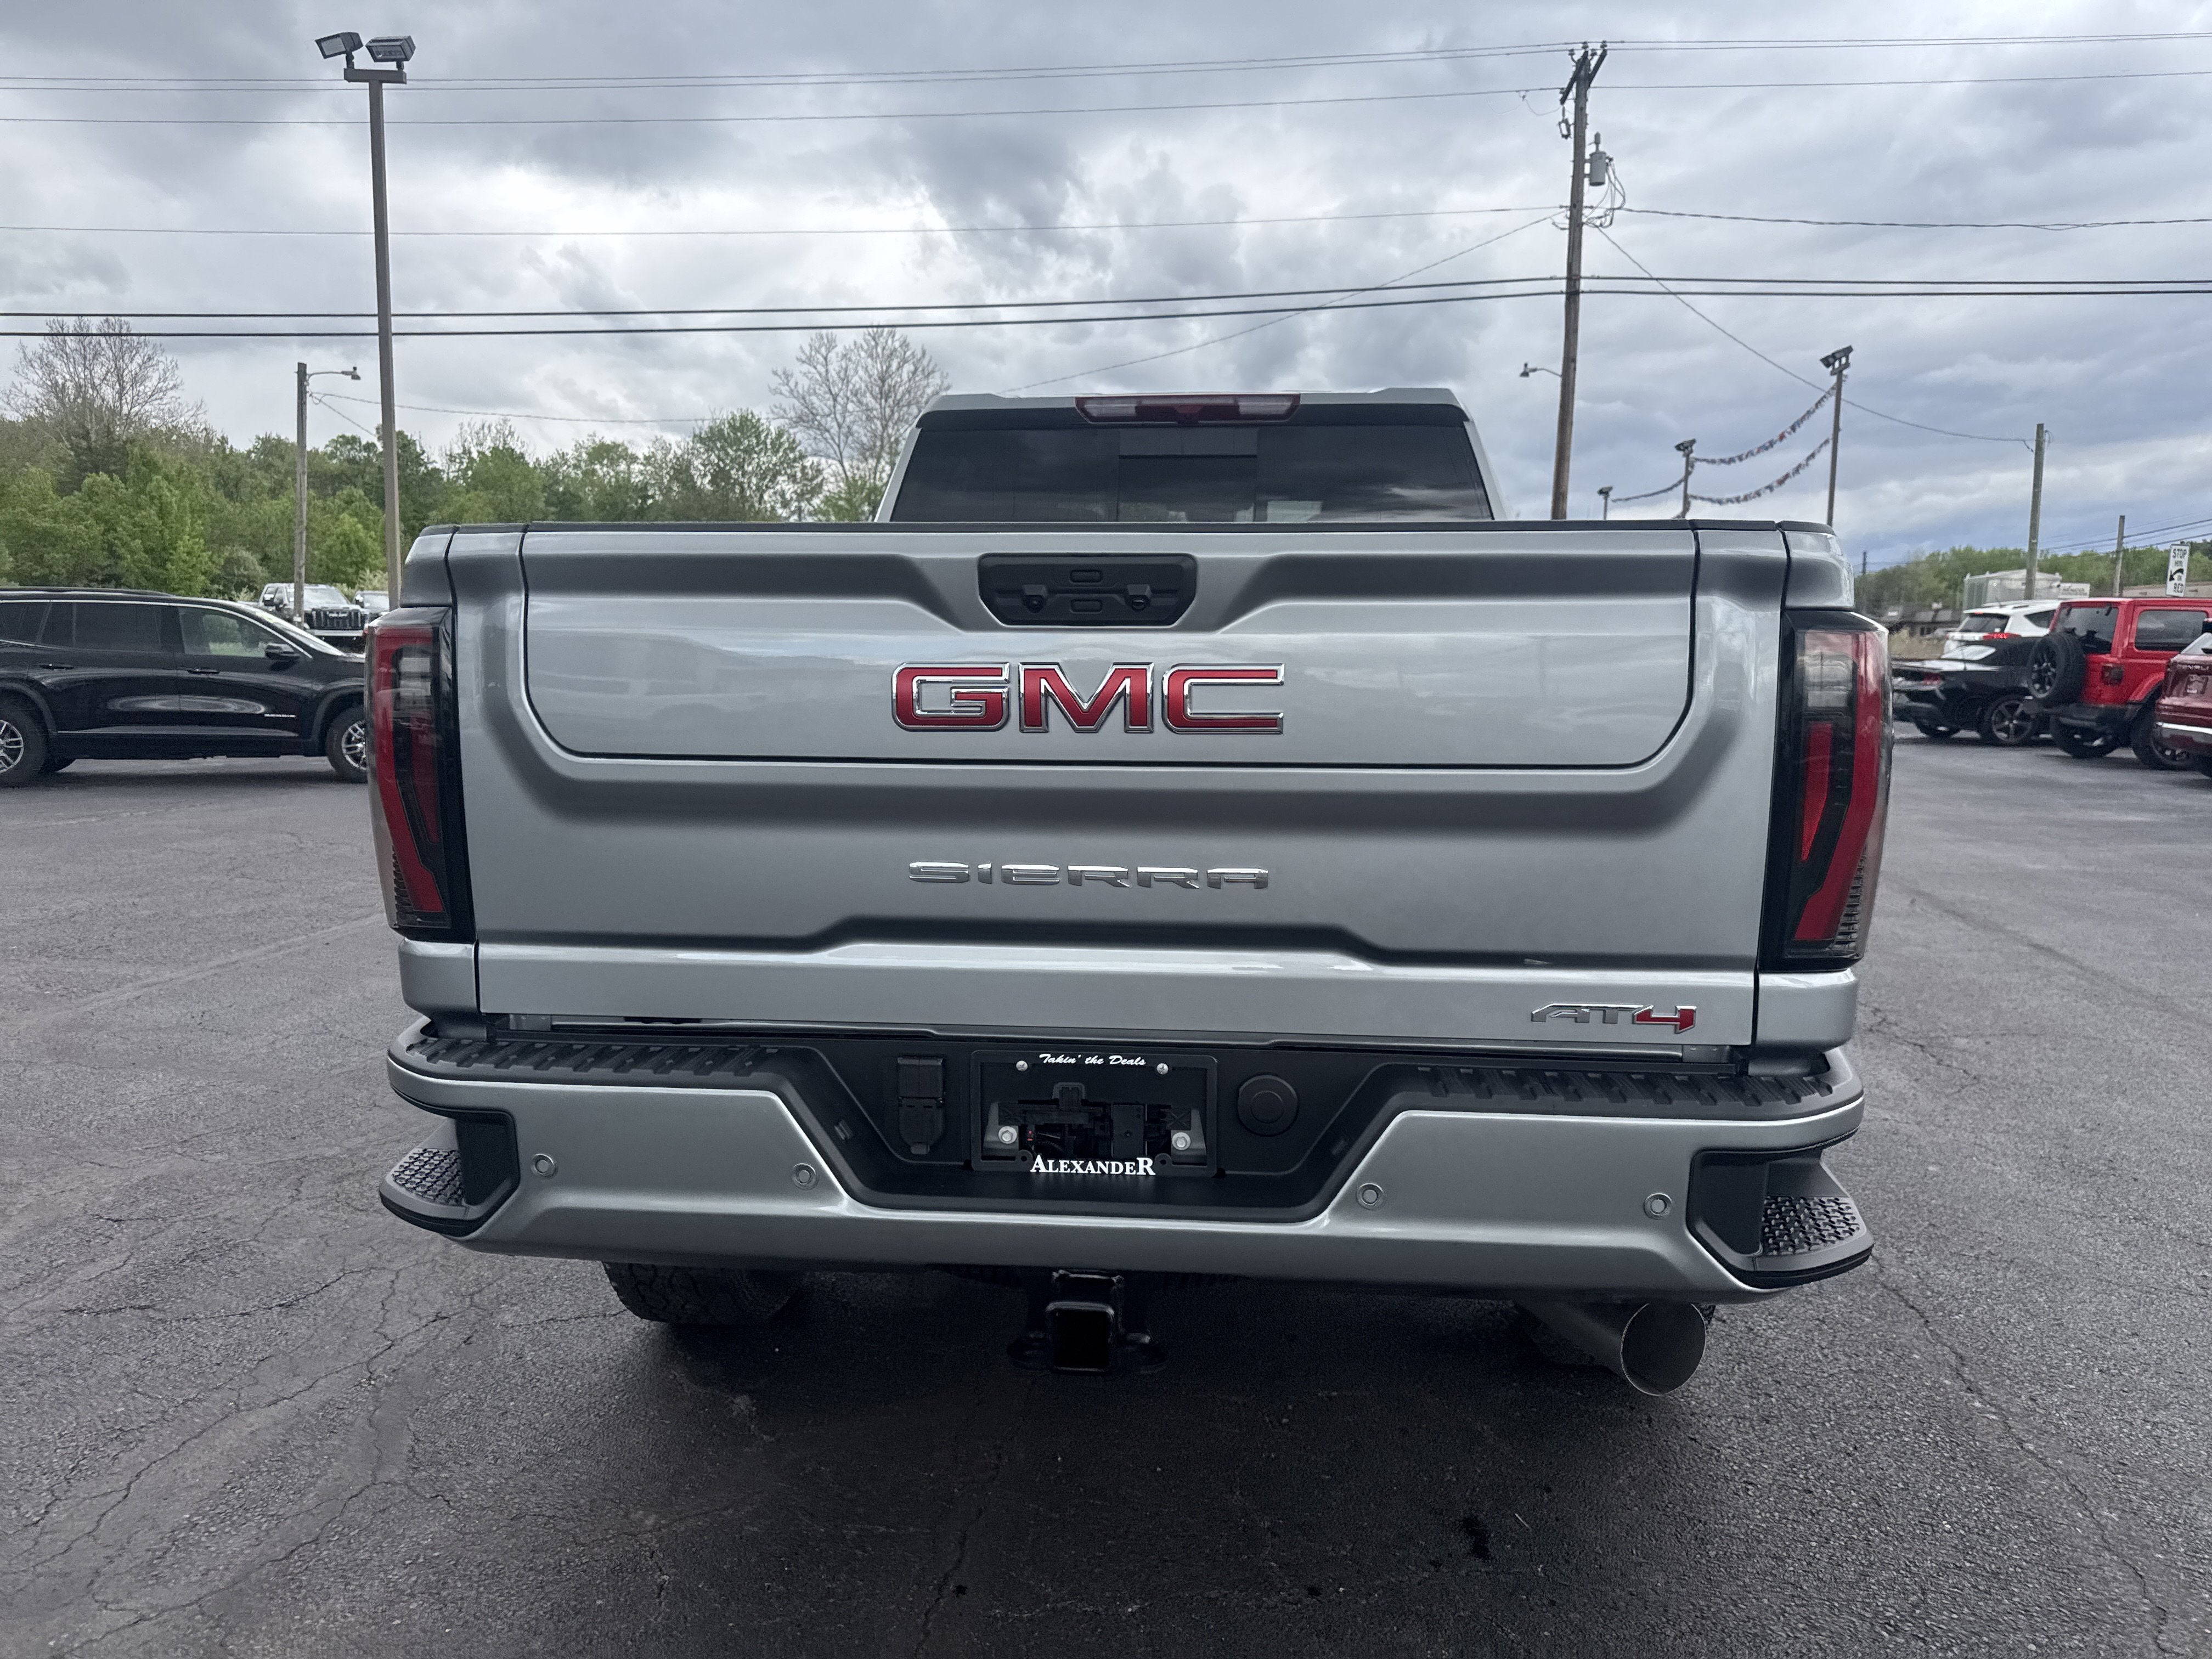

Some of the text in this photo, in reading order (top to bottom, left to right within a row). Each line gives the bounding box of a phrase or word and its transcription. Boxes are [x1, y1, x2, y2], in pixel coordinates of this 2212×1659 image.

[2172, 548, 2187, 558] STOP
[891, 662, 1285, 734] GMC
[909, 861, 1269, 889] SIERRA
[1531, 1002, 1697, 1034] AT4
[1039, 1053, 1147, 1065] Takin' the Deals
[1030, 1154, 1156, 1176] ALEXANDER
